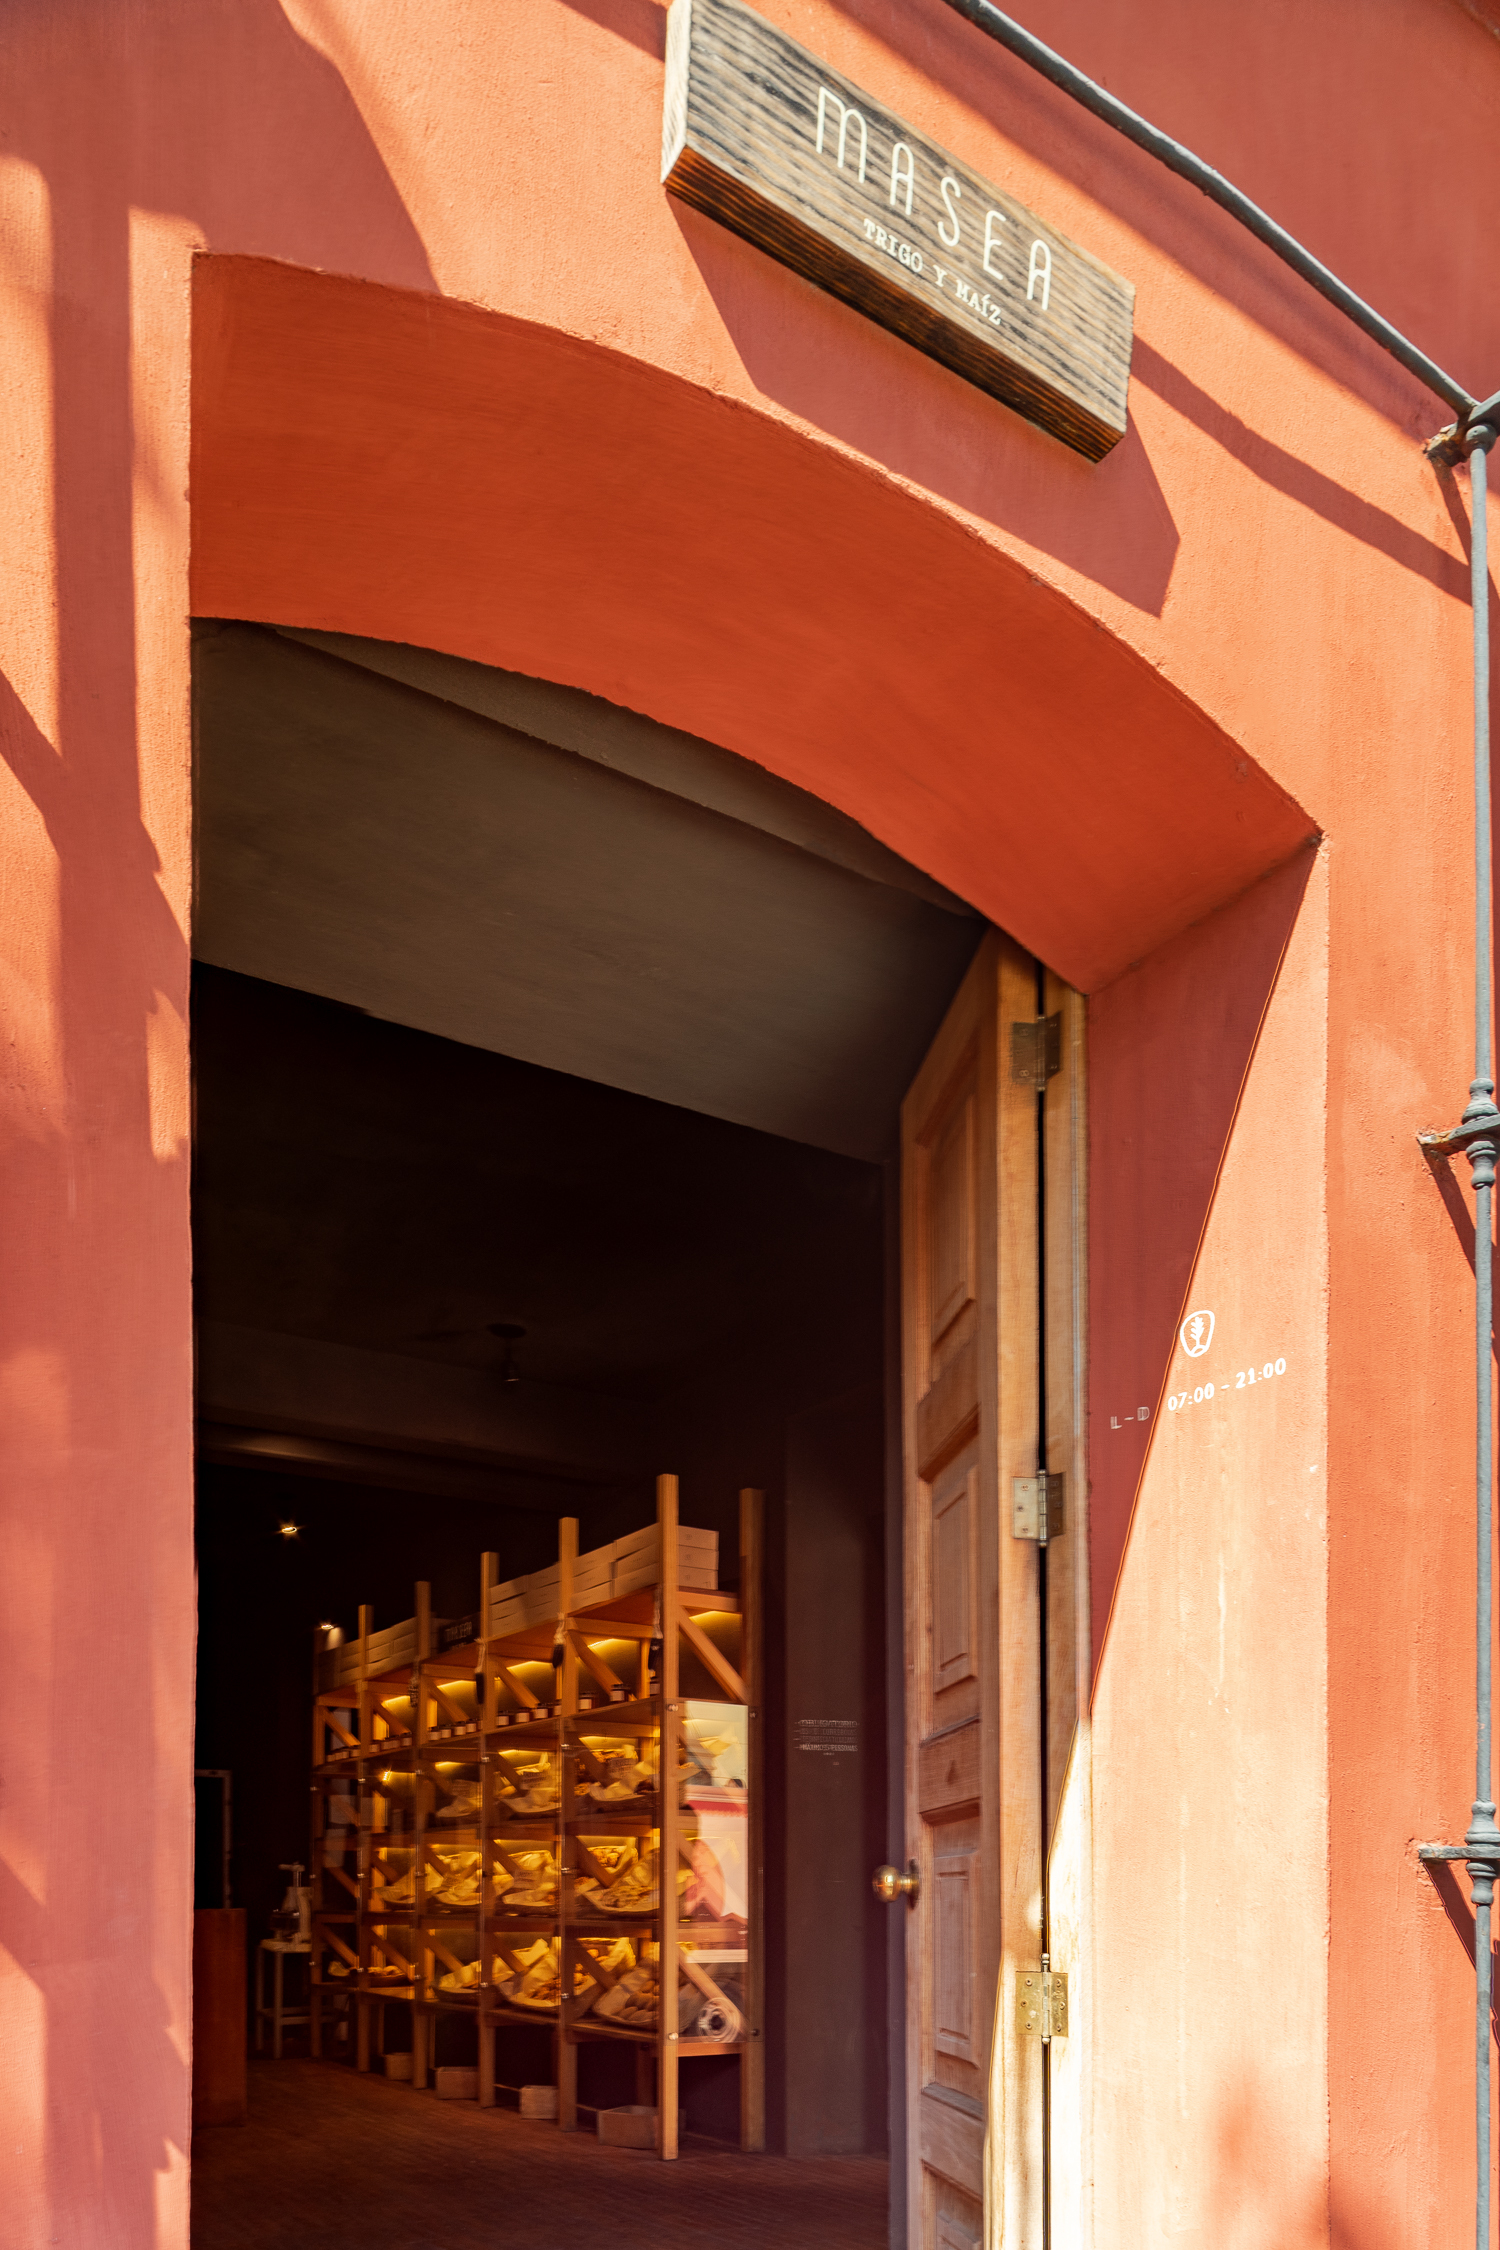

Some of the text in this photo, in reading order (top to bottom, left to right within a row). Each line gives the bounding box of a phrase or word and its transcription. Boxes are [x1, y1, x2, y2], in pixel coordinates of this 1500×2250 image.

[815, 86, 1052, 311] MASEA
[863, 218, 1002, 326] TRIGO Y MAÍZ
[1110, 1416, 1122, 1429] L
[1137, 1406, 1150, 1421] D
[1167, 1382, 1215, 1411] 07:00
[1235, 1357, 1287, 1389] 21:00
